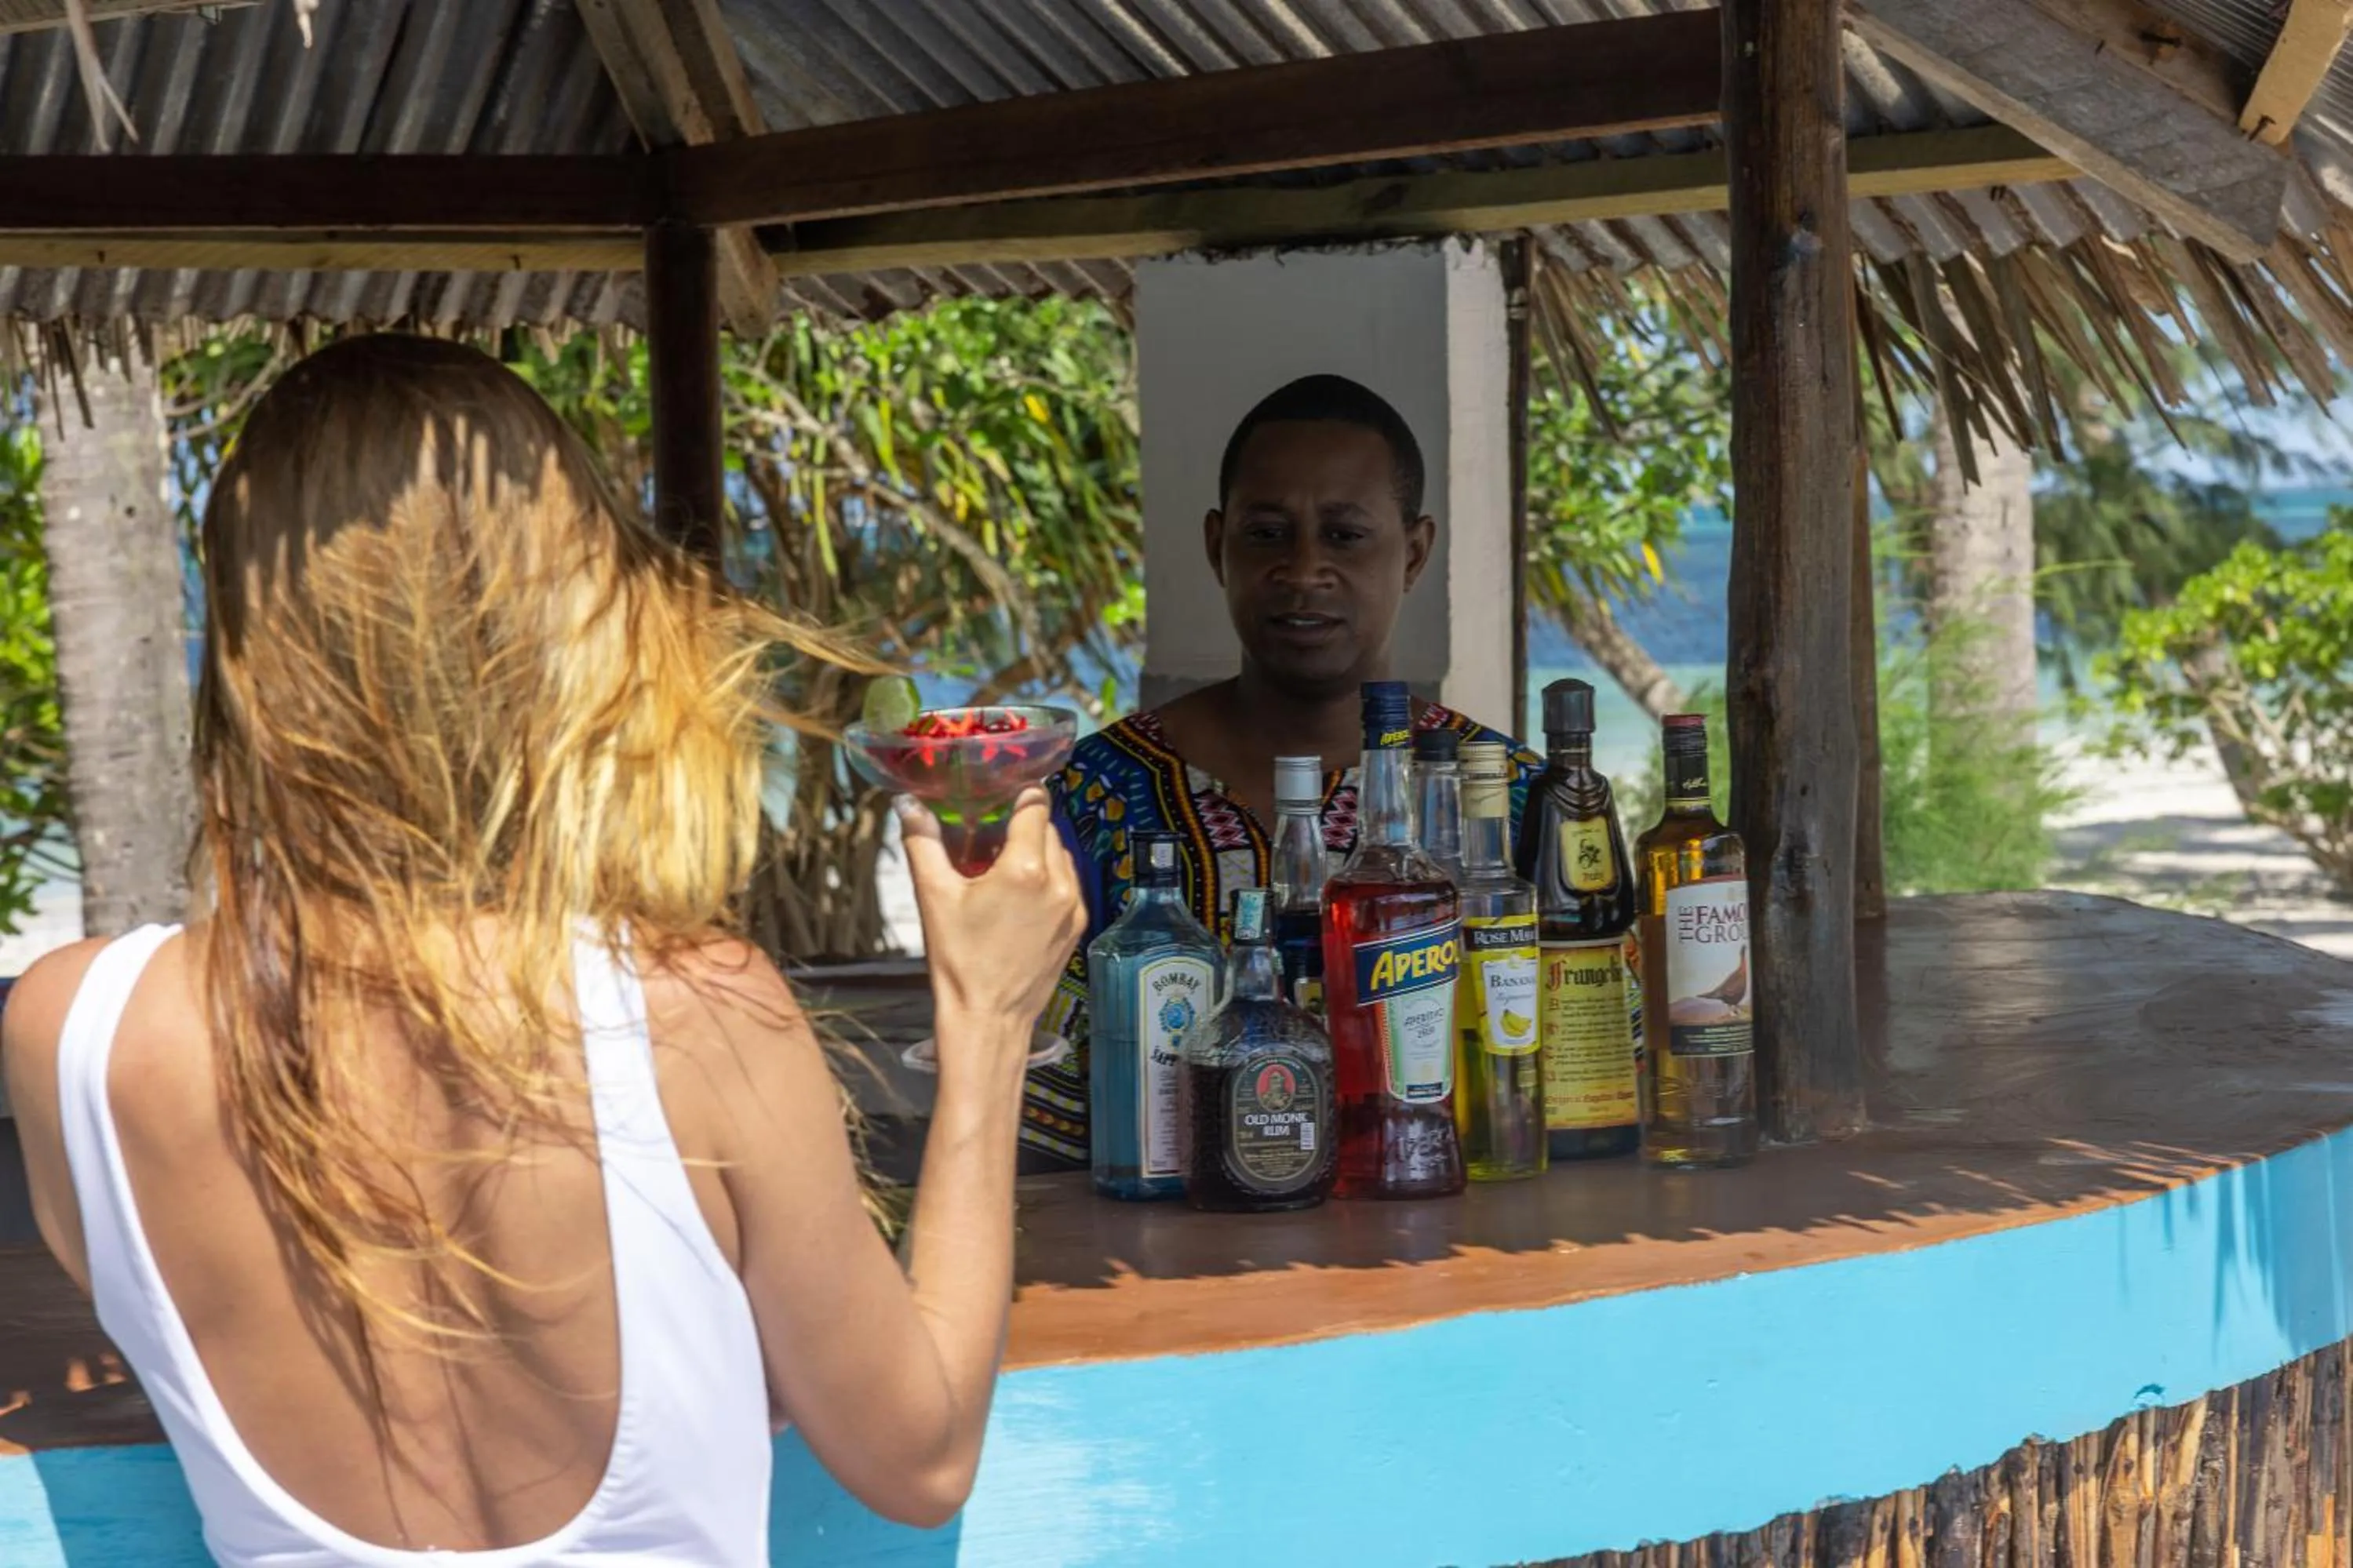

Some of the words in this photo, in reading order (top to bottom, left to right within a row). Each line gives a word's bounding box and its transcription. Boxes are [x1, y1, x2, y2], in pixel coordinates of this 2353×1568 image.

[1696, 903, 1745, 924] FAMO
[1152, 972, 1201, 994] BOMBAY
[1245, 1114, 1269, 1125] OLD
[1270, 1112, 1309, 1124] MONK
[1262, 1125, 1291, 1137] RUM
